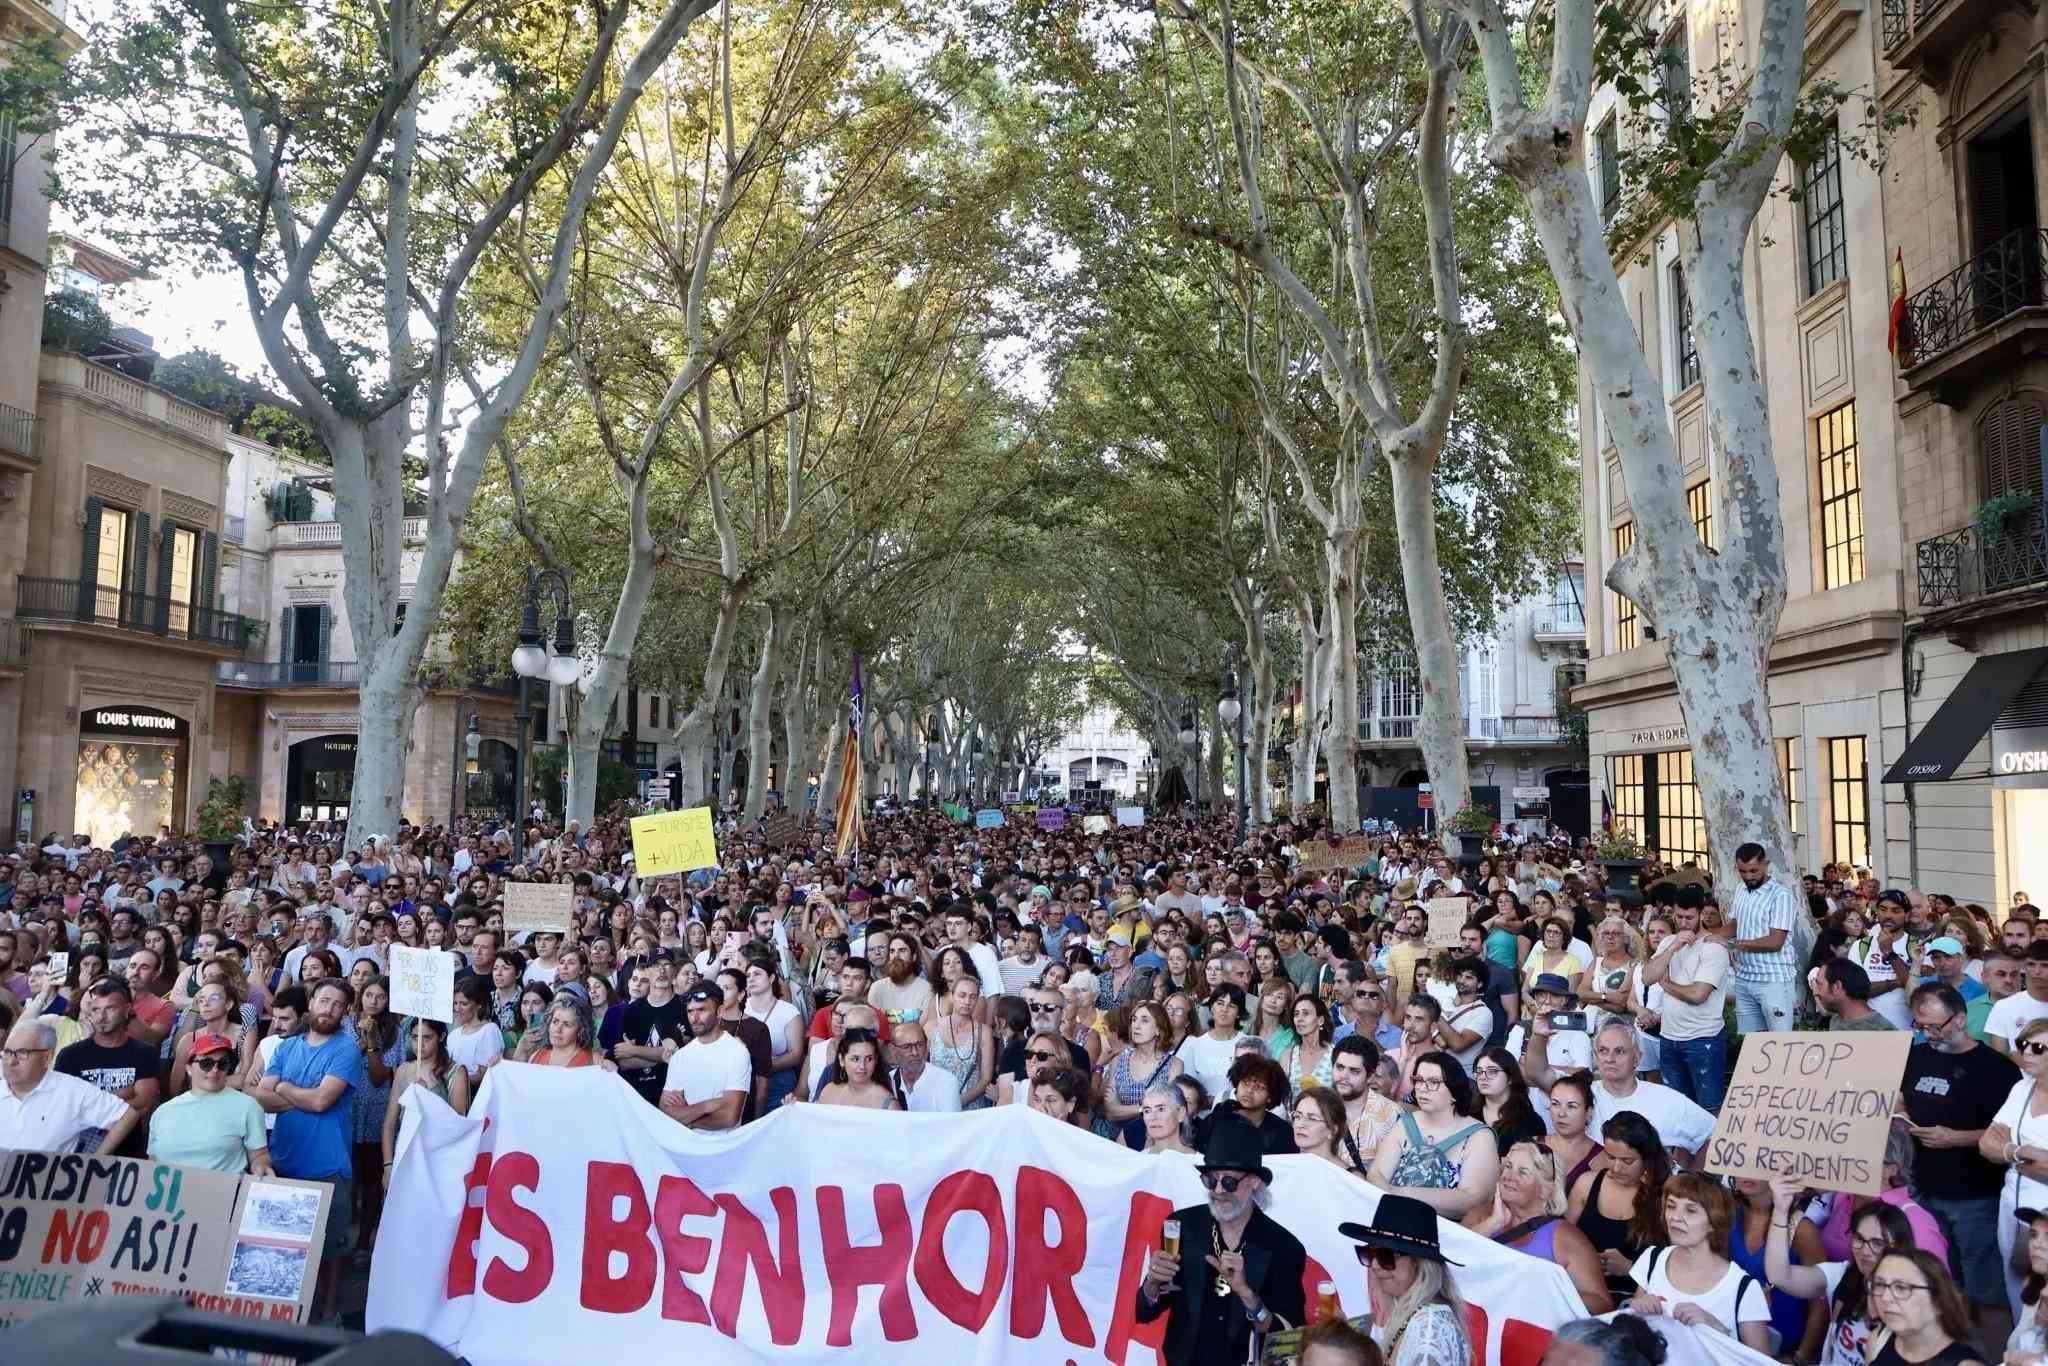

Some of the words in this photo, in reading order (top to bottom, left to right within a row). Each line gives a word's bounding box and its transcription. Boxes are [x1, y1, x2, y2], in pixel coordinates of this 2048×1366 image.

[96, 712, 129, 726] LOUIS
[131, 714, 176, 730] VUITTON
[1632, 731, 1656, 743] ZARA
[1659, 727, 1686, 741] HOME
[1907, 764, 1942, 775] OYSHO
[1752, 1040, 1854, 1080] STOP
[1726, 1084, 1896, 1119] ESPECULATION
[1726, 1114, 1746, 1134] IN
[1755, 1114, 1851, 1145] HOUSING
[1710, 1138, 1748, 1168] SOS
[1756, 1146, 1871, 1184] RESIDENTS
[41, 1208, 110, 1264] NO
